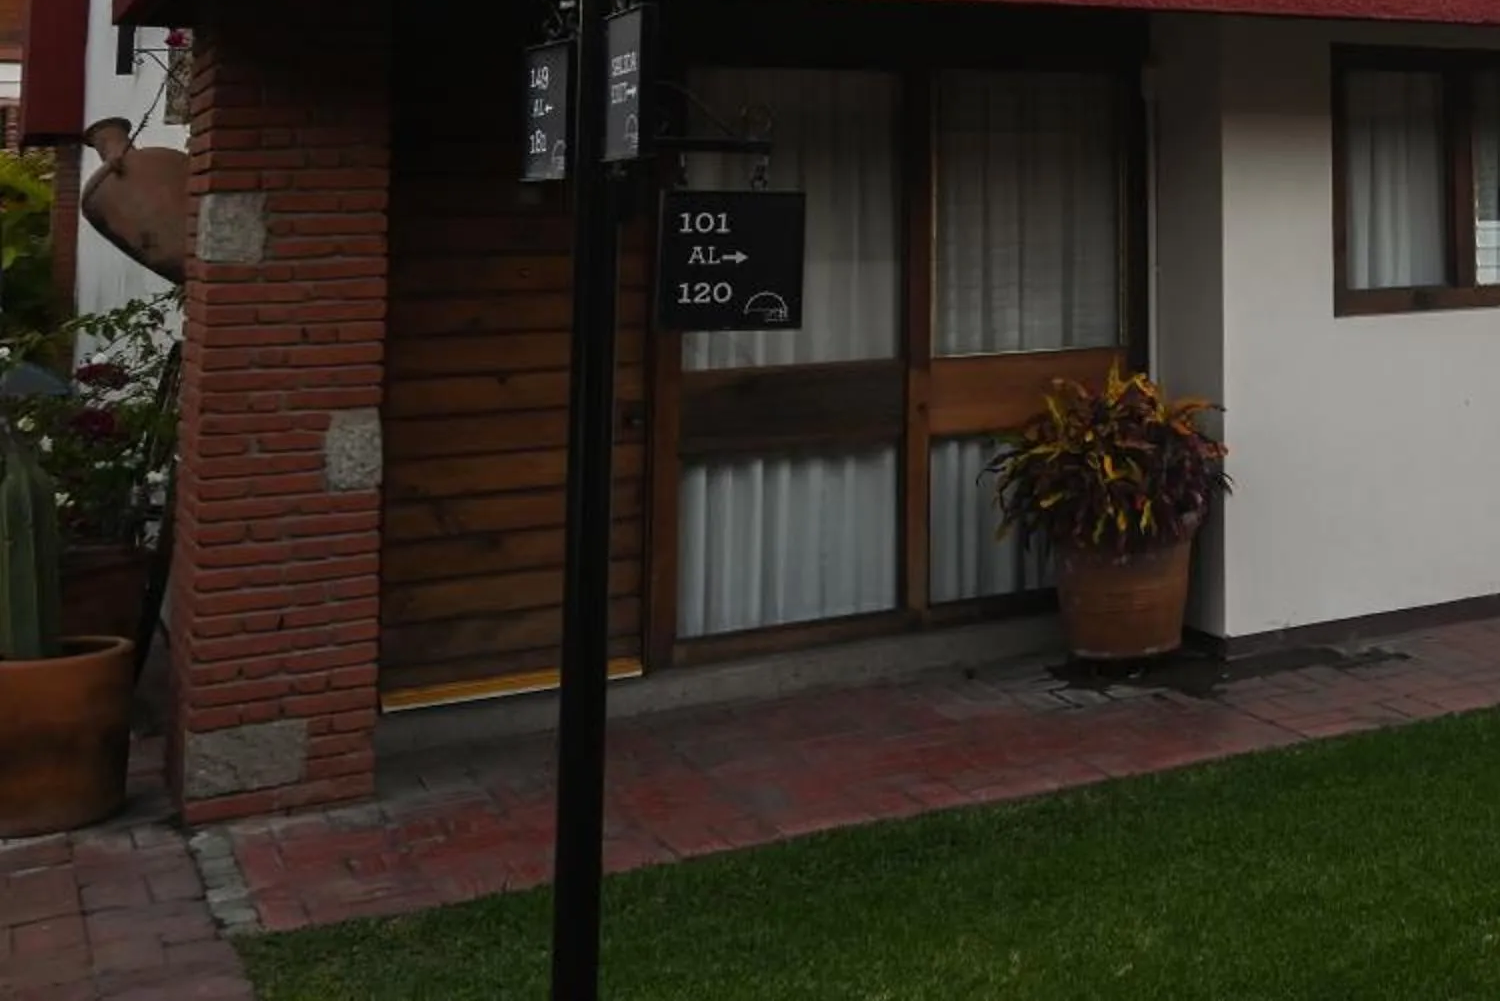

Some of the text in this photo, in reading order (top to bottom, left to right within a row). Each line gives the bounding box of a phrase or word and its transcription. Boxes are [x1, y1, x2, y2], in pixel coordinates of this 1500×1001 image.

[679, 212, 731, 233] 101
[688, 246, 721, 265] AL
[677, 282, 732, 304] 120
